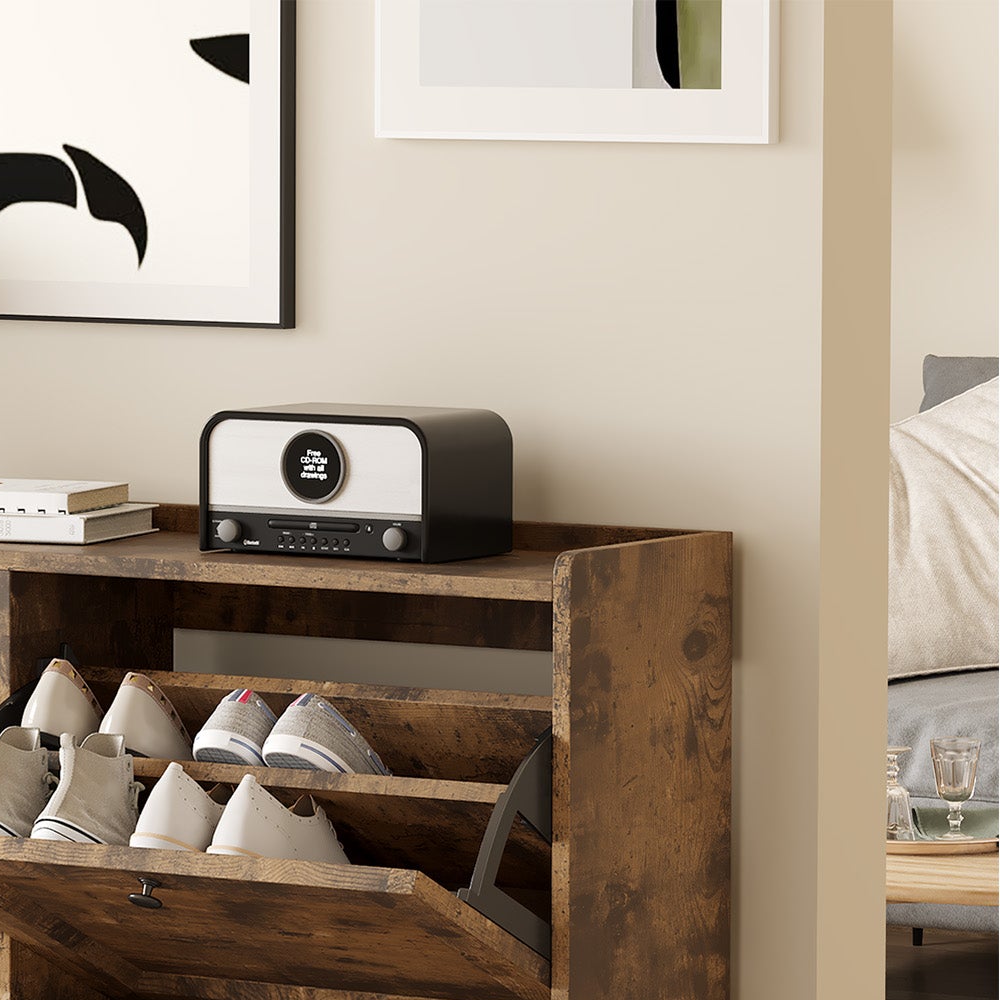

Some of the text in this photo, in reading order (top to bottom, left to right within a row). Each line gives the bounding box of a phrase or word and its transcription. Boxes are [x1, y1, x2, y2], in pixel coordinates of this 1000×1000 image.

[306, 449, 321, 457] Free
[300, 456, 328, 464] CD-ROM
[317, 464, 325, 472] all
[300, 471, 328, 481] drawings
